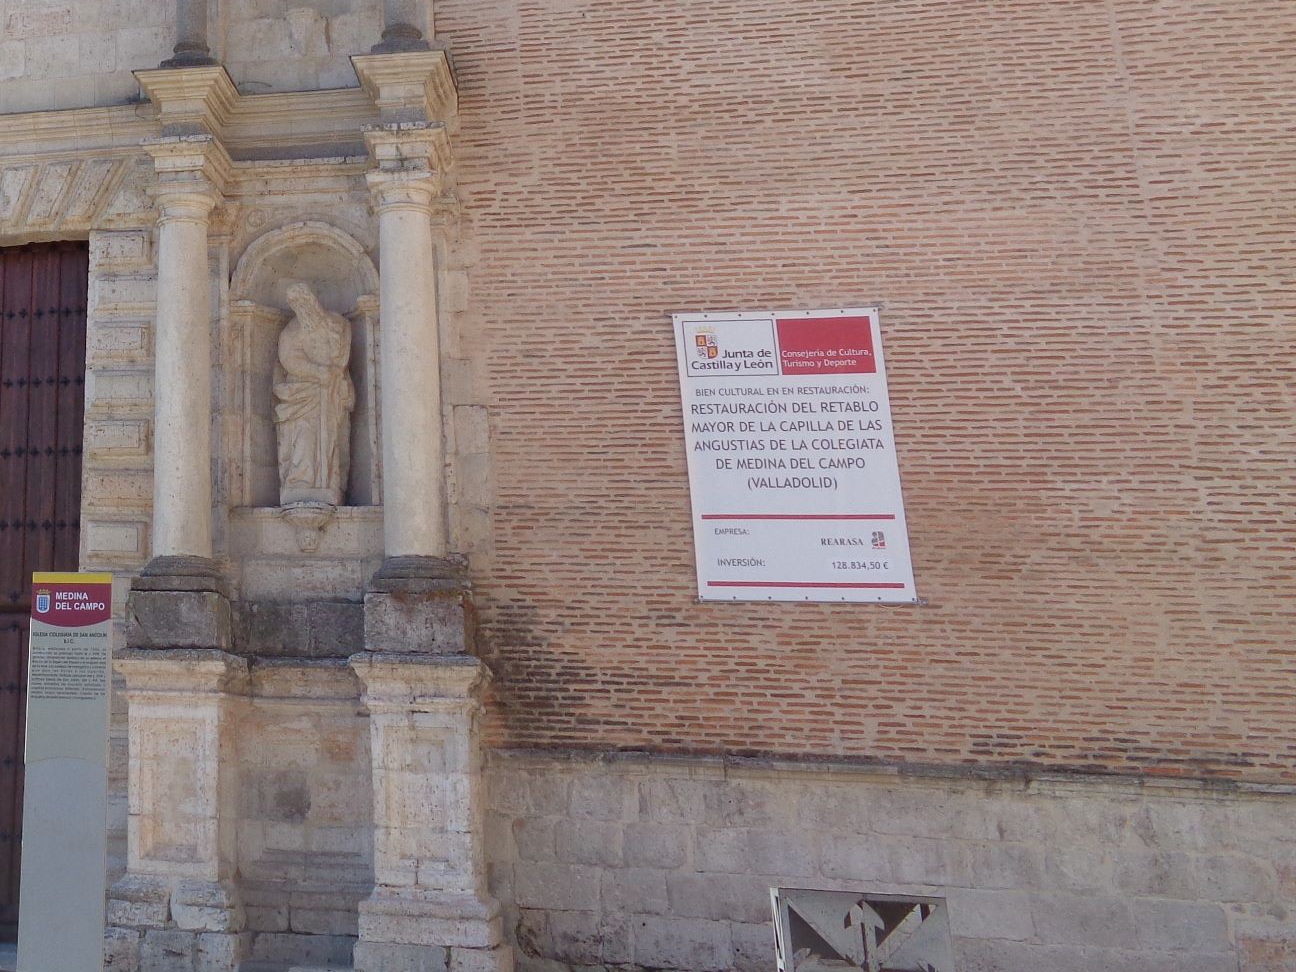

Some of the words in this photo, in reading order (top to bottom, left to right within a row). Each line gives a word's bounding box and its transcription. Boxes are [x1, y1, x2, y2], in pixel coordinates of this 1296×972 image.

[722, 350, 754, 359] Junta
[757, 349, 772, 358] de
[838, 348, 872, 357] Cultura,
[691, 360, 732, 370] Castilla
[733, 362, 741, 371] y
[744, 359, 773, 369] León
[782, 360, 815, 368] Turismo
[817, 360, 822, 368] y
[824, 358, 856, 368] Deporte
[696, 388, 716, 396] BIEN
[718, 388, 764, 396] CULTURAL
[767, 387, 779, 395] EN
[782, 387, 795, 395] EN
[797, 384, 870, 395] RESTAURACIÓN:
[691, 400, 787, 414] RESTAURACIÓN
[792, 402, 816, 414] DEL
[820, 401, 878, 412] RETABLO
[691, 421, 735, 433] MAYOR
[739, 421, 757, 432] DE
[760, 421, 777, 432] LA
[779, 420, 834, 432] CAPILLA
[838, 420, 855, 431] DE
[858, 420, 882, 431] LAS
[694, 440, 765, 451] ANGUSTIAS
[770, 440, 788, 450] DE
[791, 440, 808, 450] LA
[811, 439, 884, 450] COLEGIATA
[716, 458, 733, 470] DE
[736, 458, 786, 469] MEDINA
[790, 458, 815, 469] DEL
[818, 458, 866, 469] CAMPO
[747, 476, 838, 490] (VALLADOLID)
[820, 538, 864, 546] REARASA
[717, 558, 766, 567] INVERSIÓN:
[832, 562, 880, 571] 128.834,50
[55, 592, 88, 600] MEDINA
[74, 602, 105, 610] CAMPO
